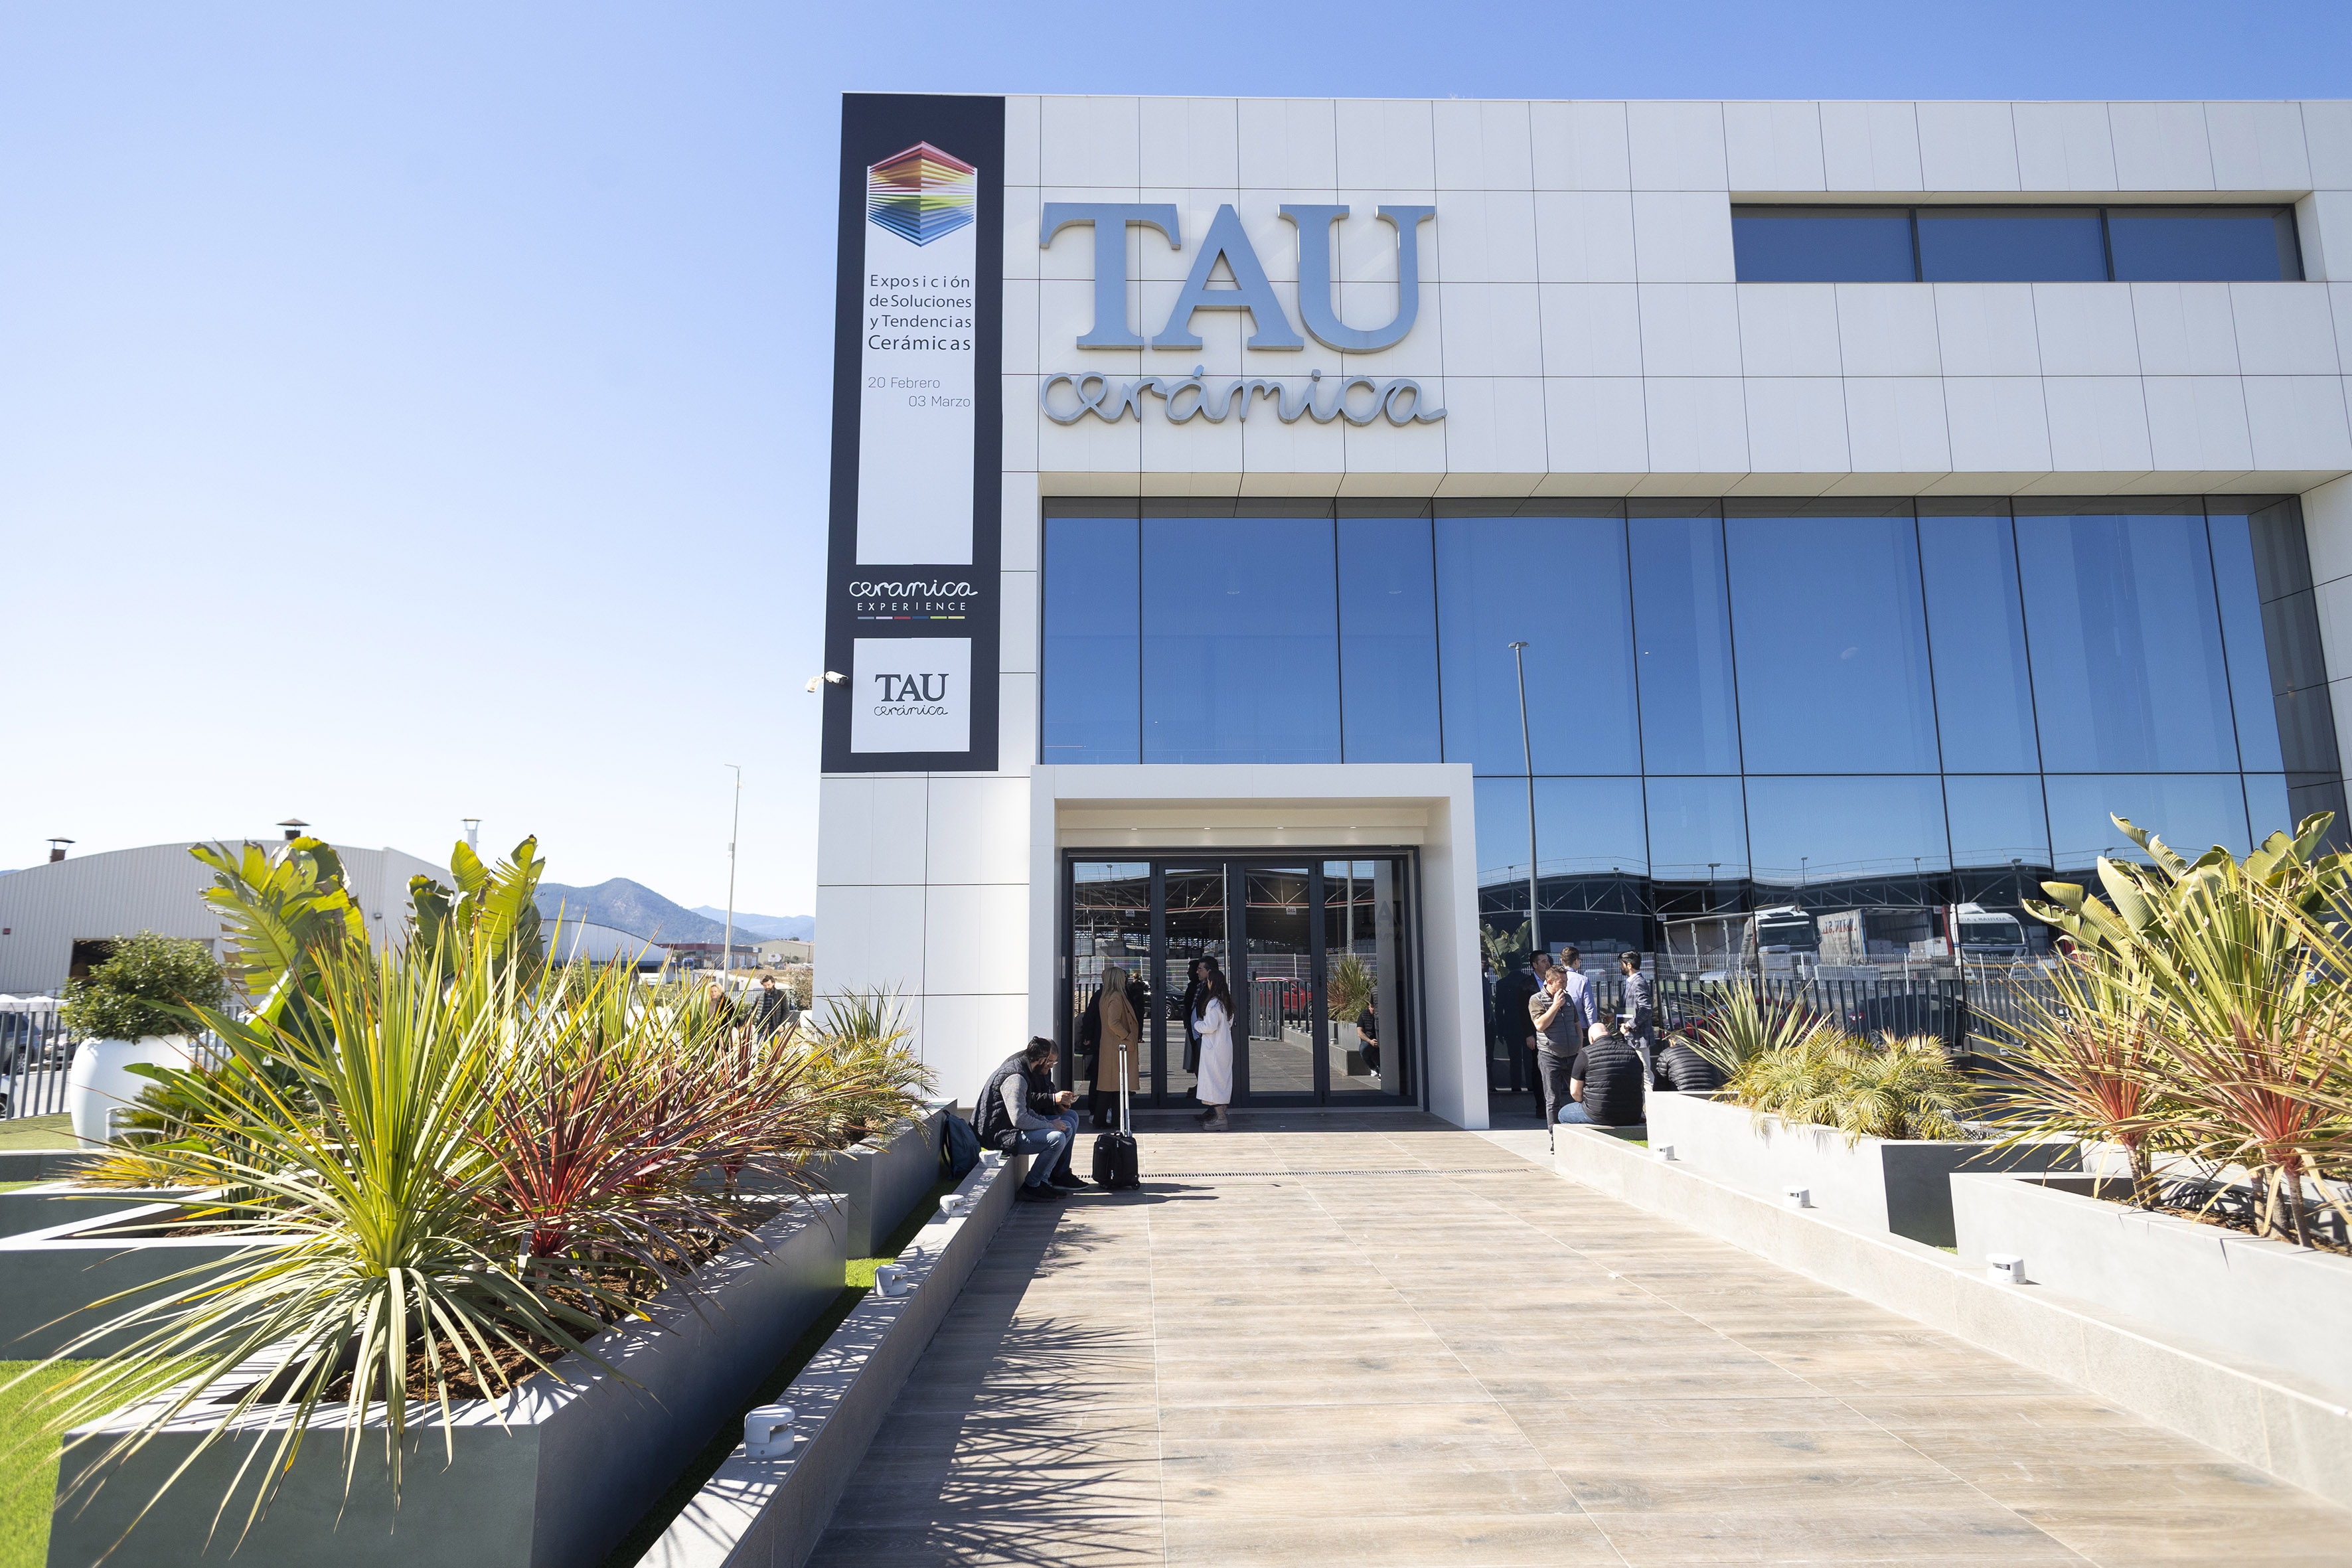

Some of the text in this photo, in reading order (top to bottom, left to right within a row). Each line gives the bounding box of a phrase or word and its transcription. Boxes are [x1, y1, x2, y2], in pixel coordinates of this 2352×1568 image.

[871, 274, 970, 289] Exposición
[1039, 202, 1436, 354] TAU
[870, 294, 971, 307] de Soluciones
[870, 315, 971, 330] y Tendencias
[868, 335, 971, 351] Cerámicas
[868, 376, 941, 388] 20 Febrero
[909, 395, 971, 407] 03 Marzo
[1040, 364, 1448, 426] cerámica
[849, 580, 978, 597] ceramica
[857, 602, 966, 611] EXPERIENCE
[874, 673, 949, 702] TAU
[874, 705, 948, 716] cerámica
